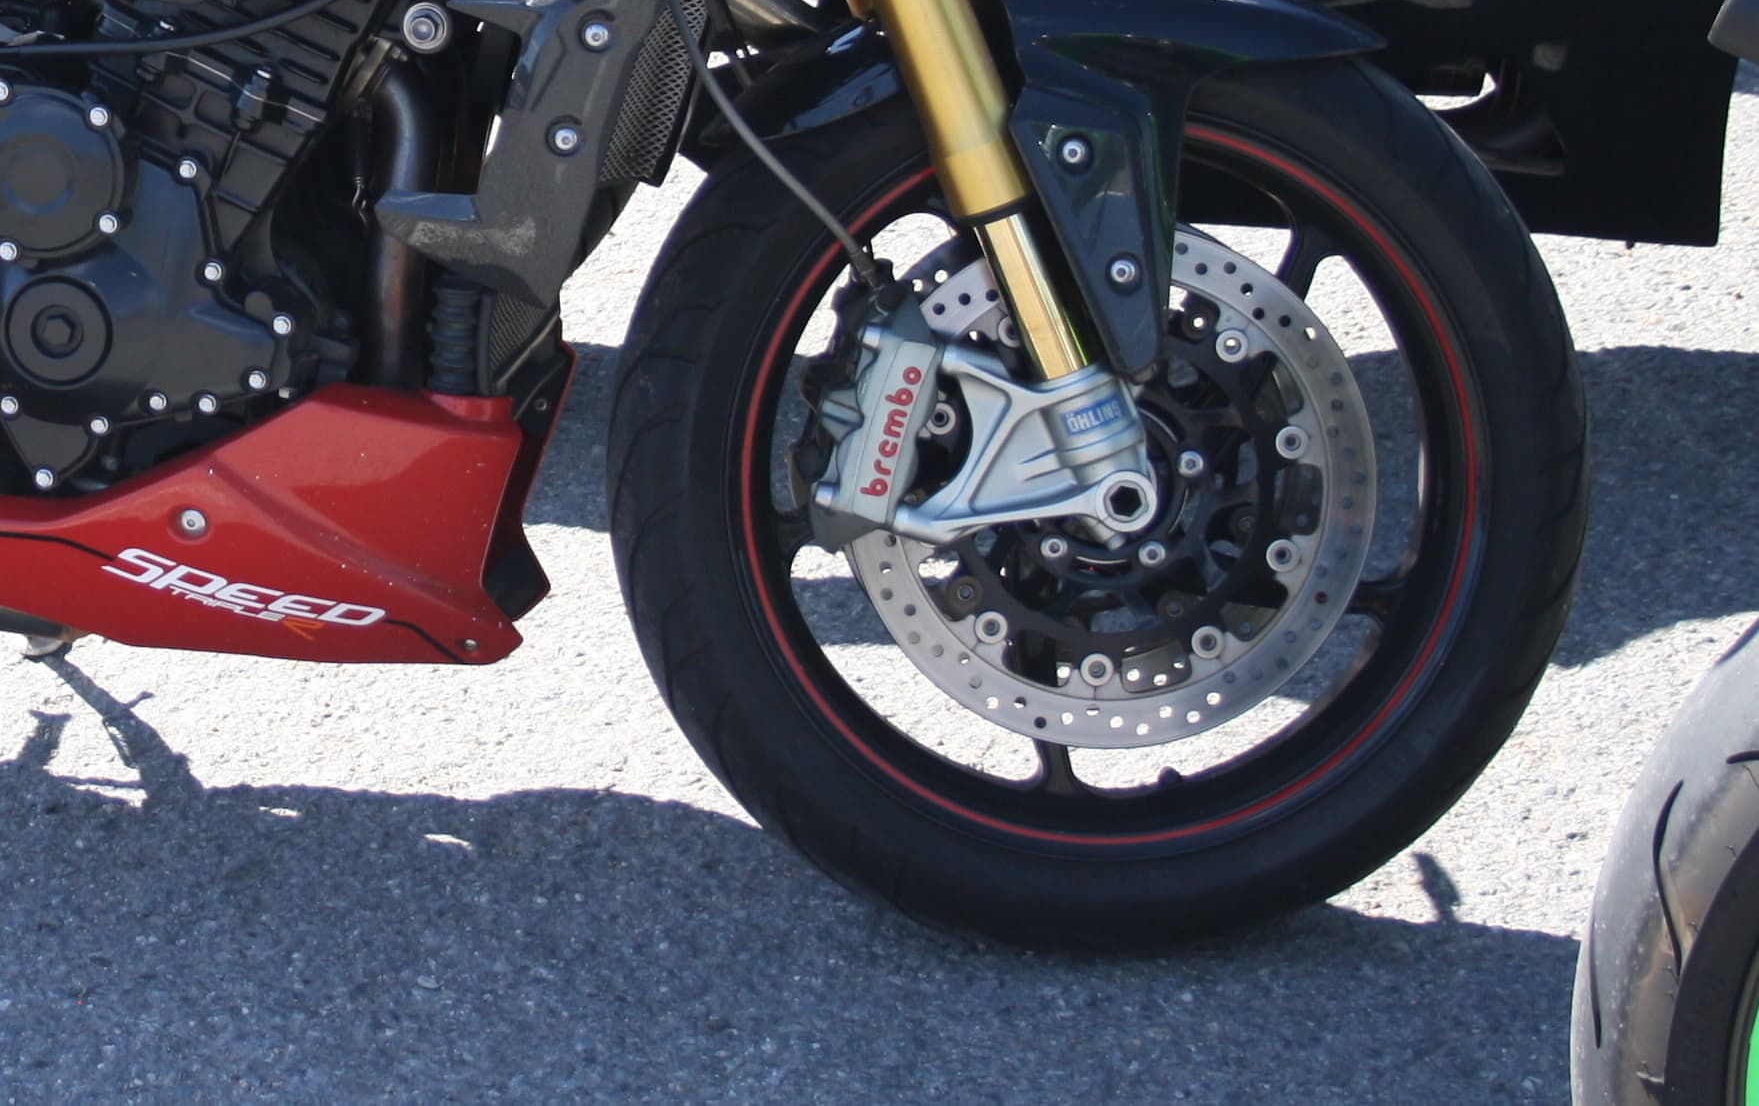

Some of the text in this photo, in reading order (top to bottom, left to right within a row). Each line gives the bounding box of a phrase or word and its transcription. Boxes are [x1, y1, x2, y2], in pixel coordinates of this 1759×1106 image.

[860, 366, 922, 497] brembo
[101, 547, 386, 626] SPEED
[170, 585, 285, 622] TRIPLE
